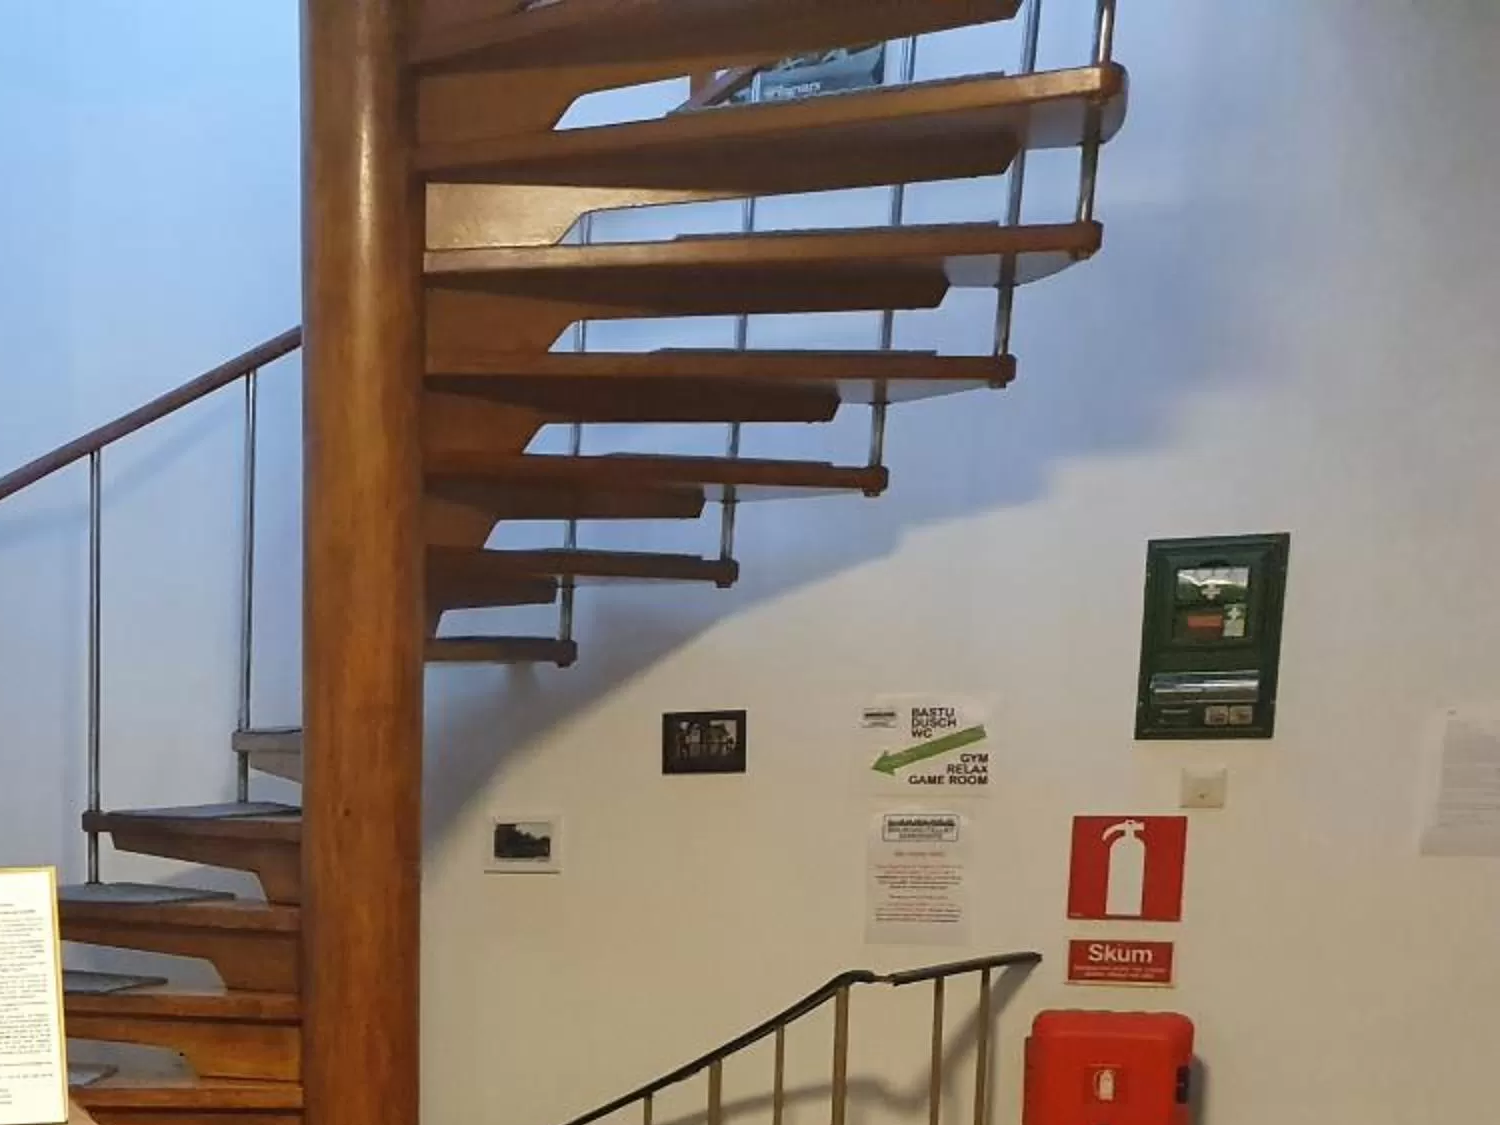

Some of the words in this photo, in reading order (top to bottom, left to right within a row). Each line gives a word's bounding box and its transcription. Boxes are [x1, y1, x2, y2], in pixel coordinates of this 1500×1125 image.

[911, 707, 955, 717] BASTU
[911, 717, 957, 728] DUSCH
[911, 728, 933, 738] WC
[960, 753, 989, 763] GYM
[947, 763, 988, 774] RELAX
[908, 775, 945, 785] GAME
[949, 775, 988, 785] ROOM
[1088, 943, 1153, 964] Skum
